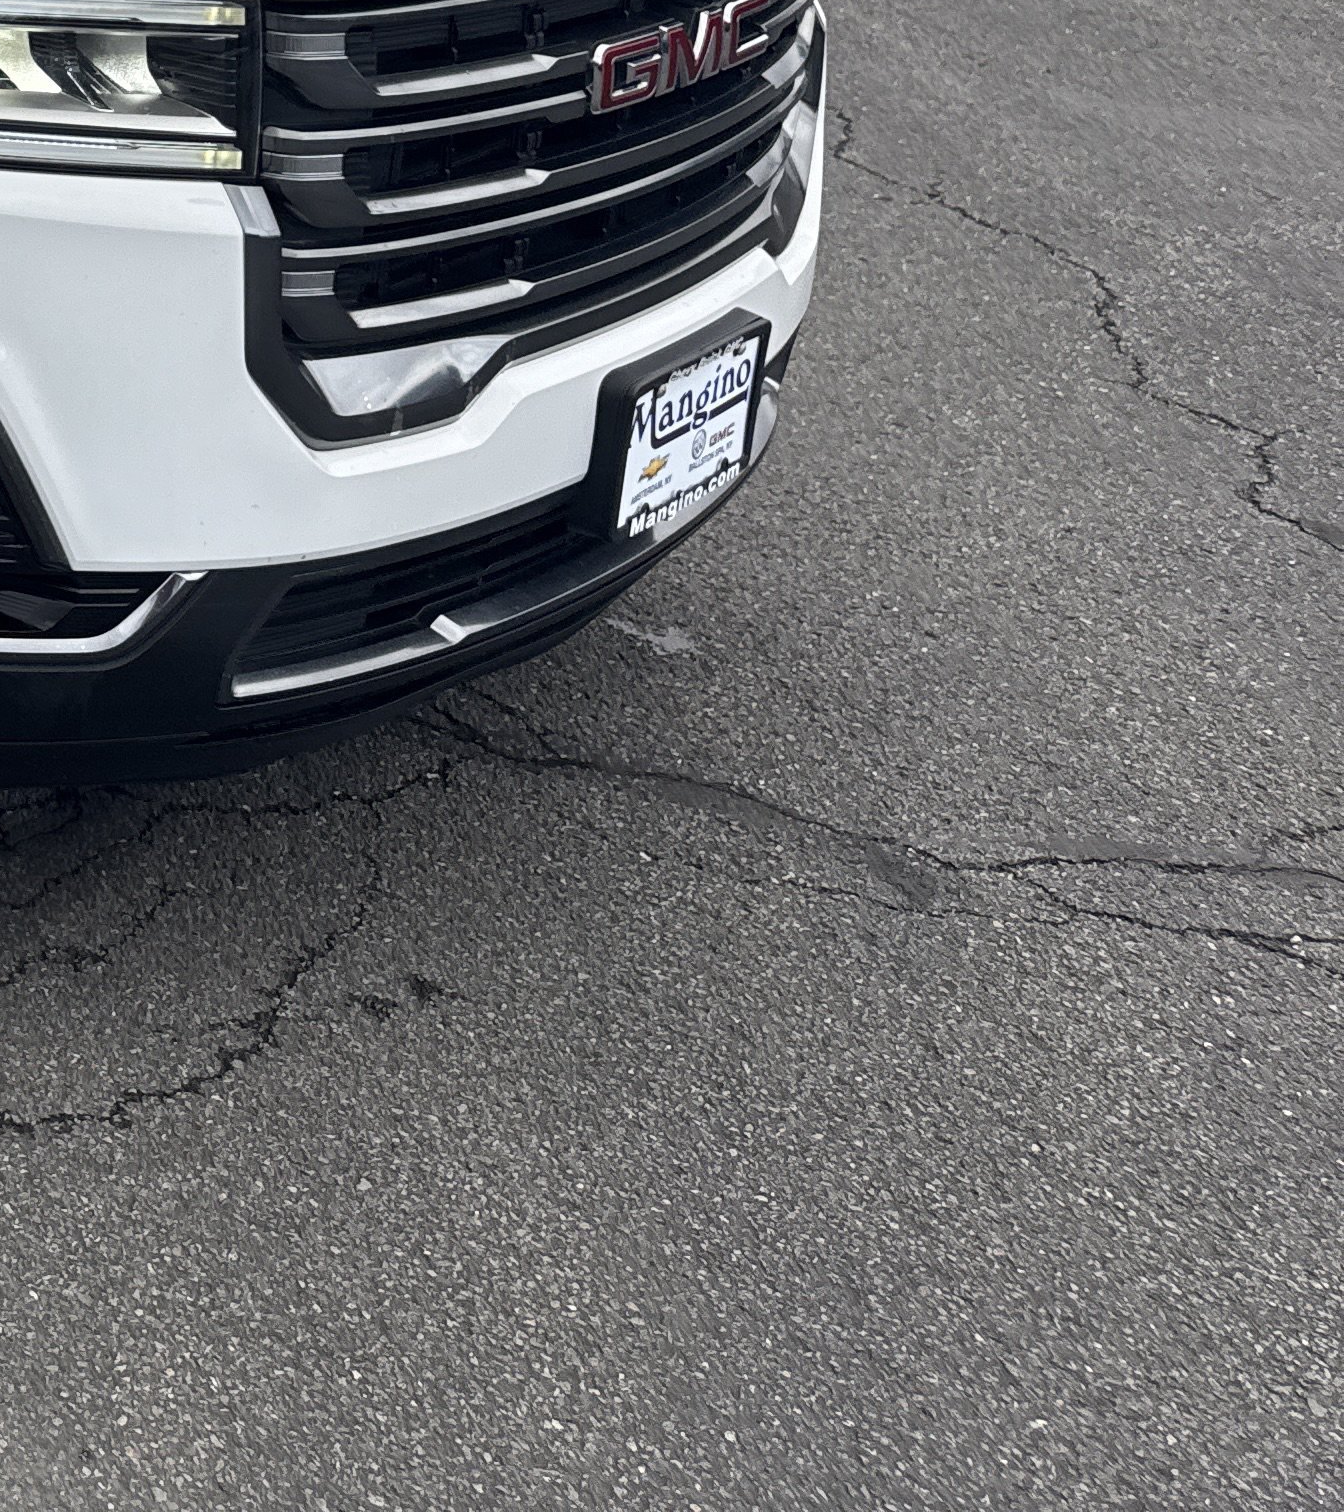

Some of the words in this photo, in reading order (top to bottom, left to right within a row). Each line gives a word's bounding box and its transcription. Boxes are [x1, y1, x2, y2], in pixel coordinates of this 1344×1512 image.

[632, 358, 752, 444] Mangino
[709, 422, 735, 447] GMC
[629, 462, 741, 538] Mangino.com
